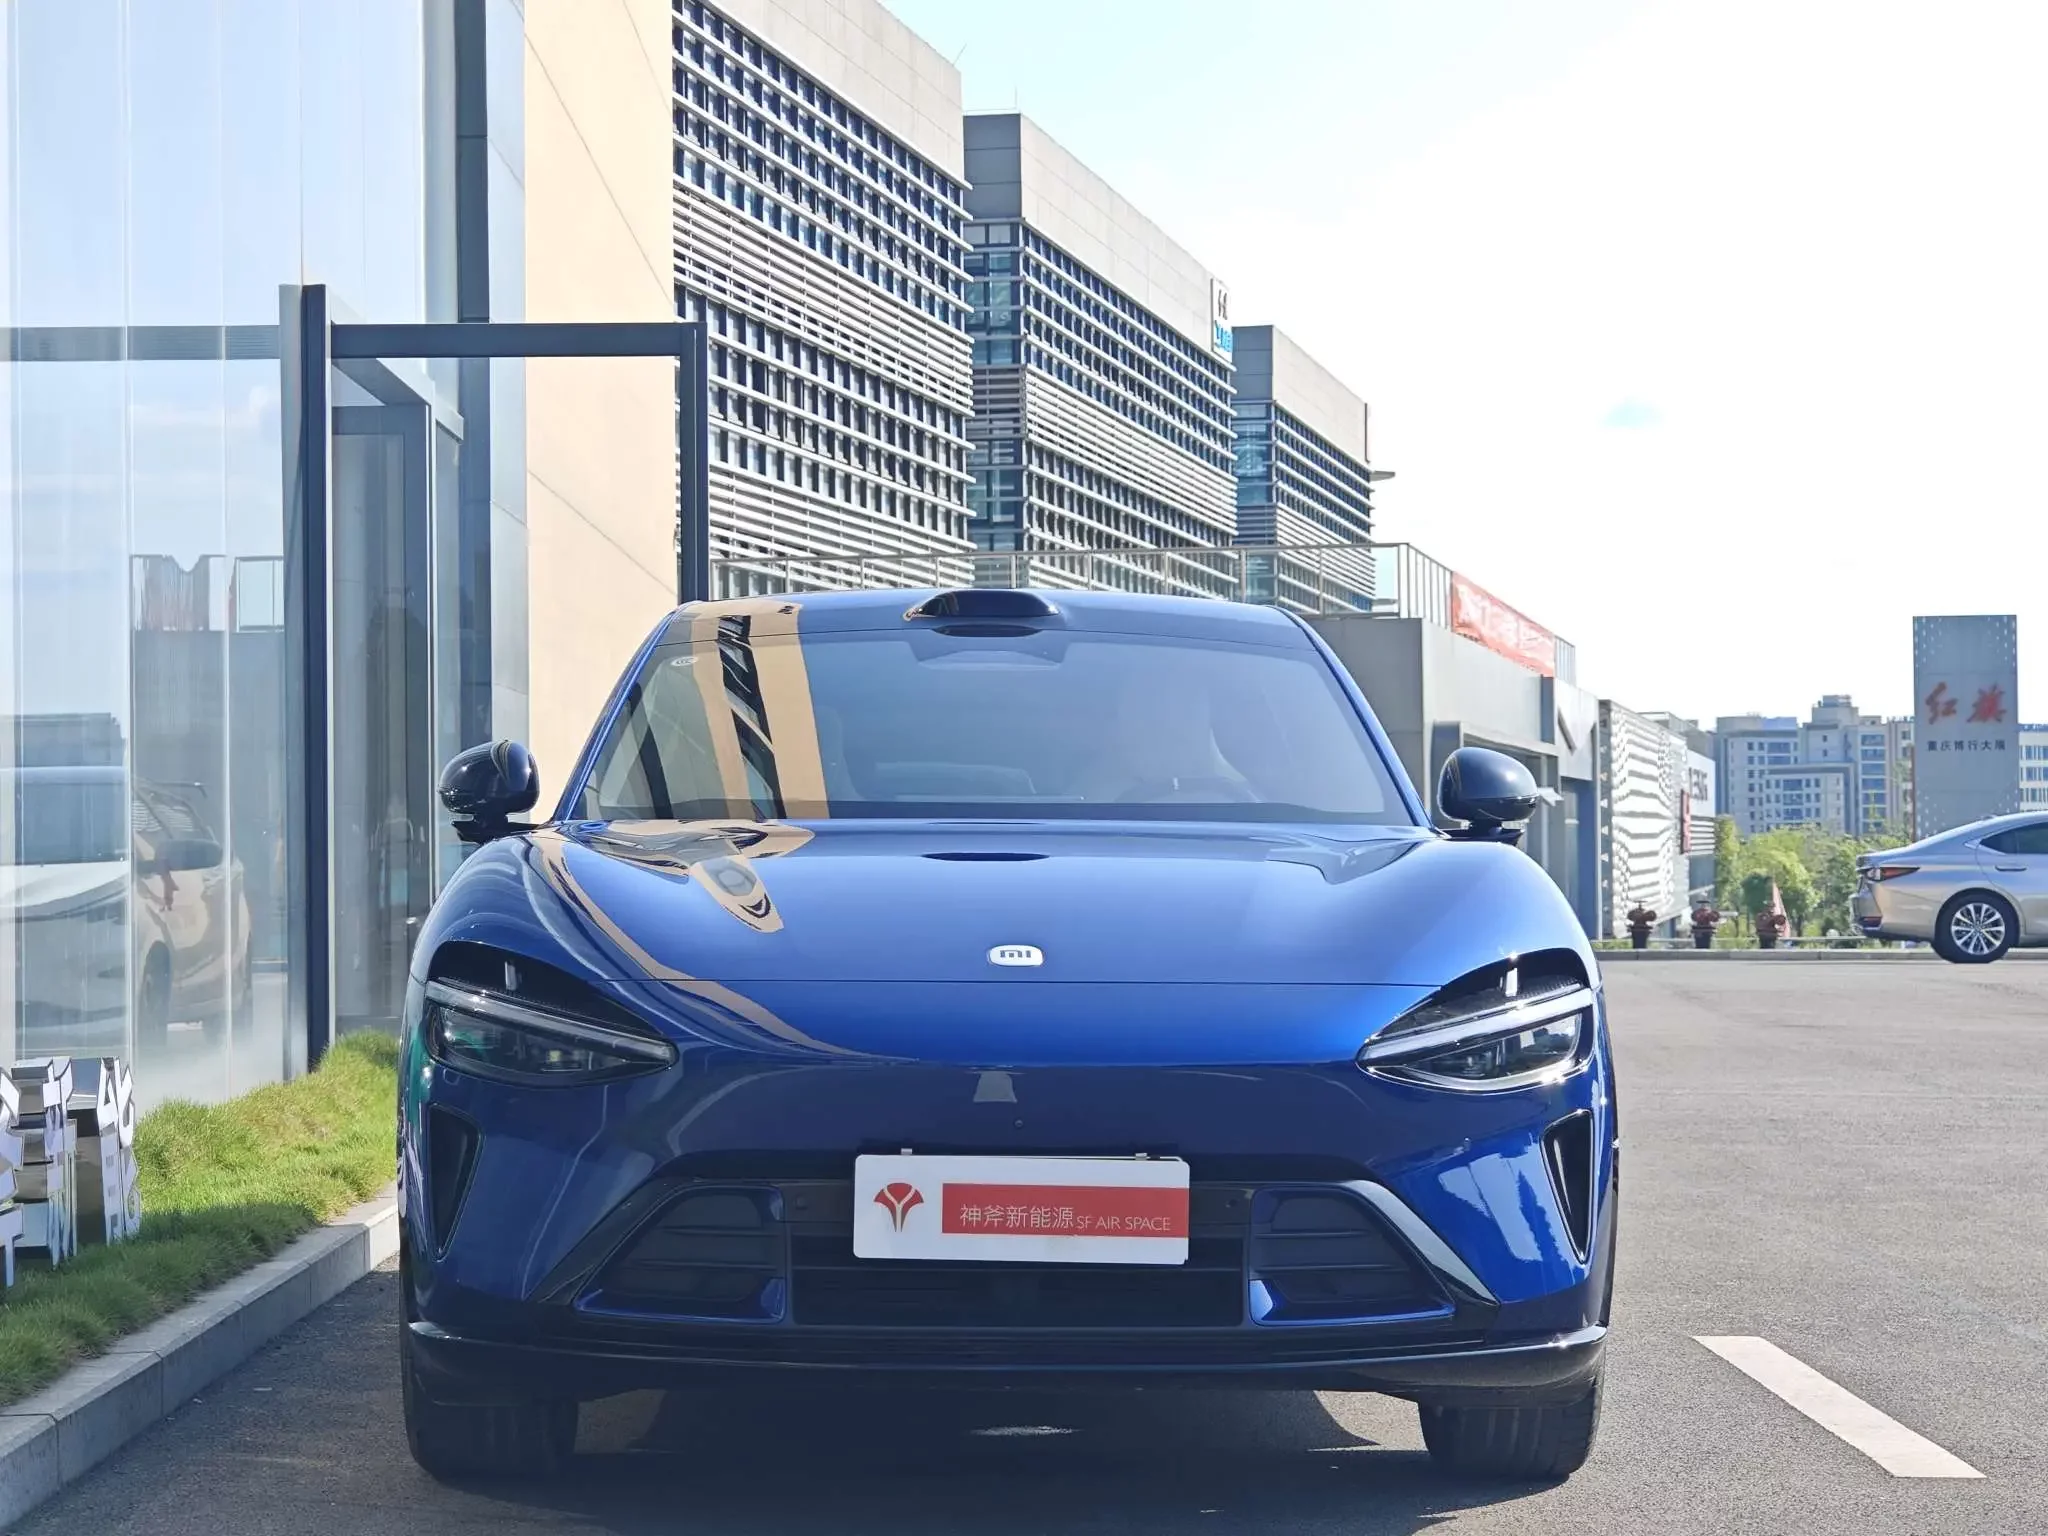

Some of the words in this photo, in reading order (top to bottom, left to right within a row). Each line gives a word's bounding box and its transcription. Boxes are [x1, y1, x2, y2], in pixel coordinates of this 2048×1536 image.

[1925, 682, 2007, 725] 红旗
[960, 1204, 1074, 1229] 神斧新能源
[1076, 1215, 1093, 1230] SF
[1096, 1216, 1121, 1231] AIR
[1125, 1216, 1171, 1232] SPACE
